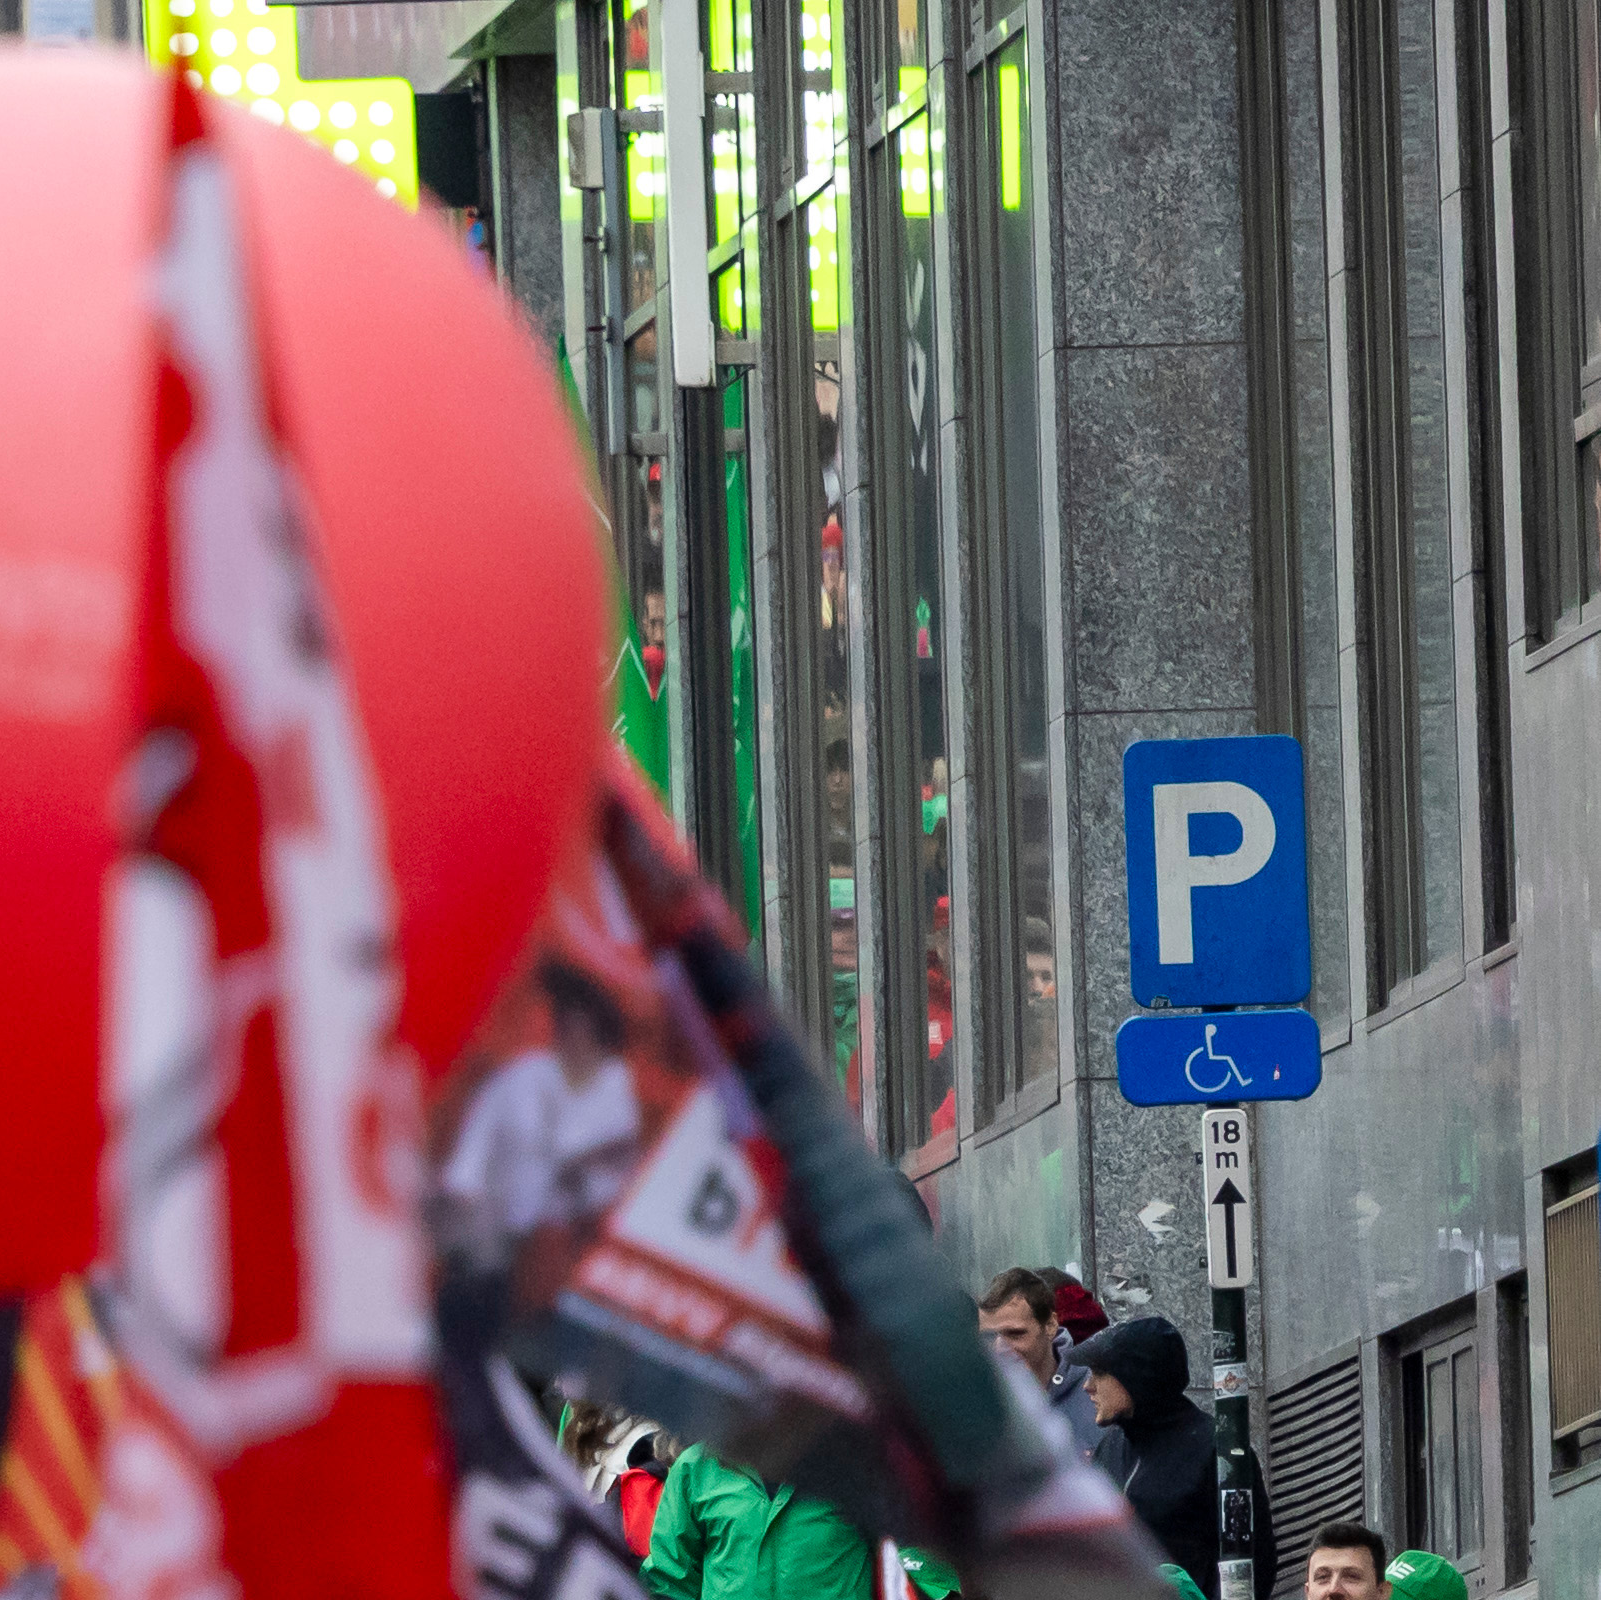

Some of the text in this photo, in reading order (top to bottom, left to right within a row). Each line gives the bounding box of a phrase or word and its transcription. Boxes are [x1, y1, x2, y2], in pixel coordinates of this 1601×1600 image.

[1153, 781, 1277, 965] P
[1211, 1120, 1240, 1144] 18
[1215, 1151, 1239, 1168] m
